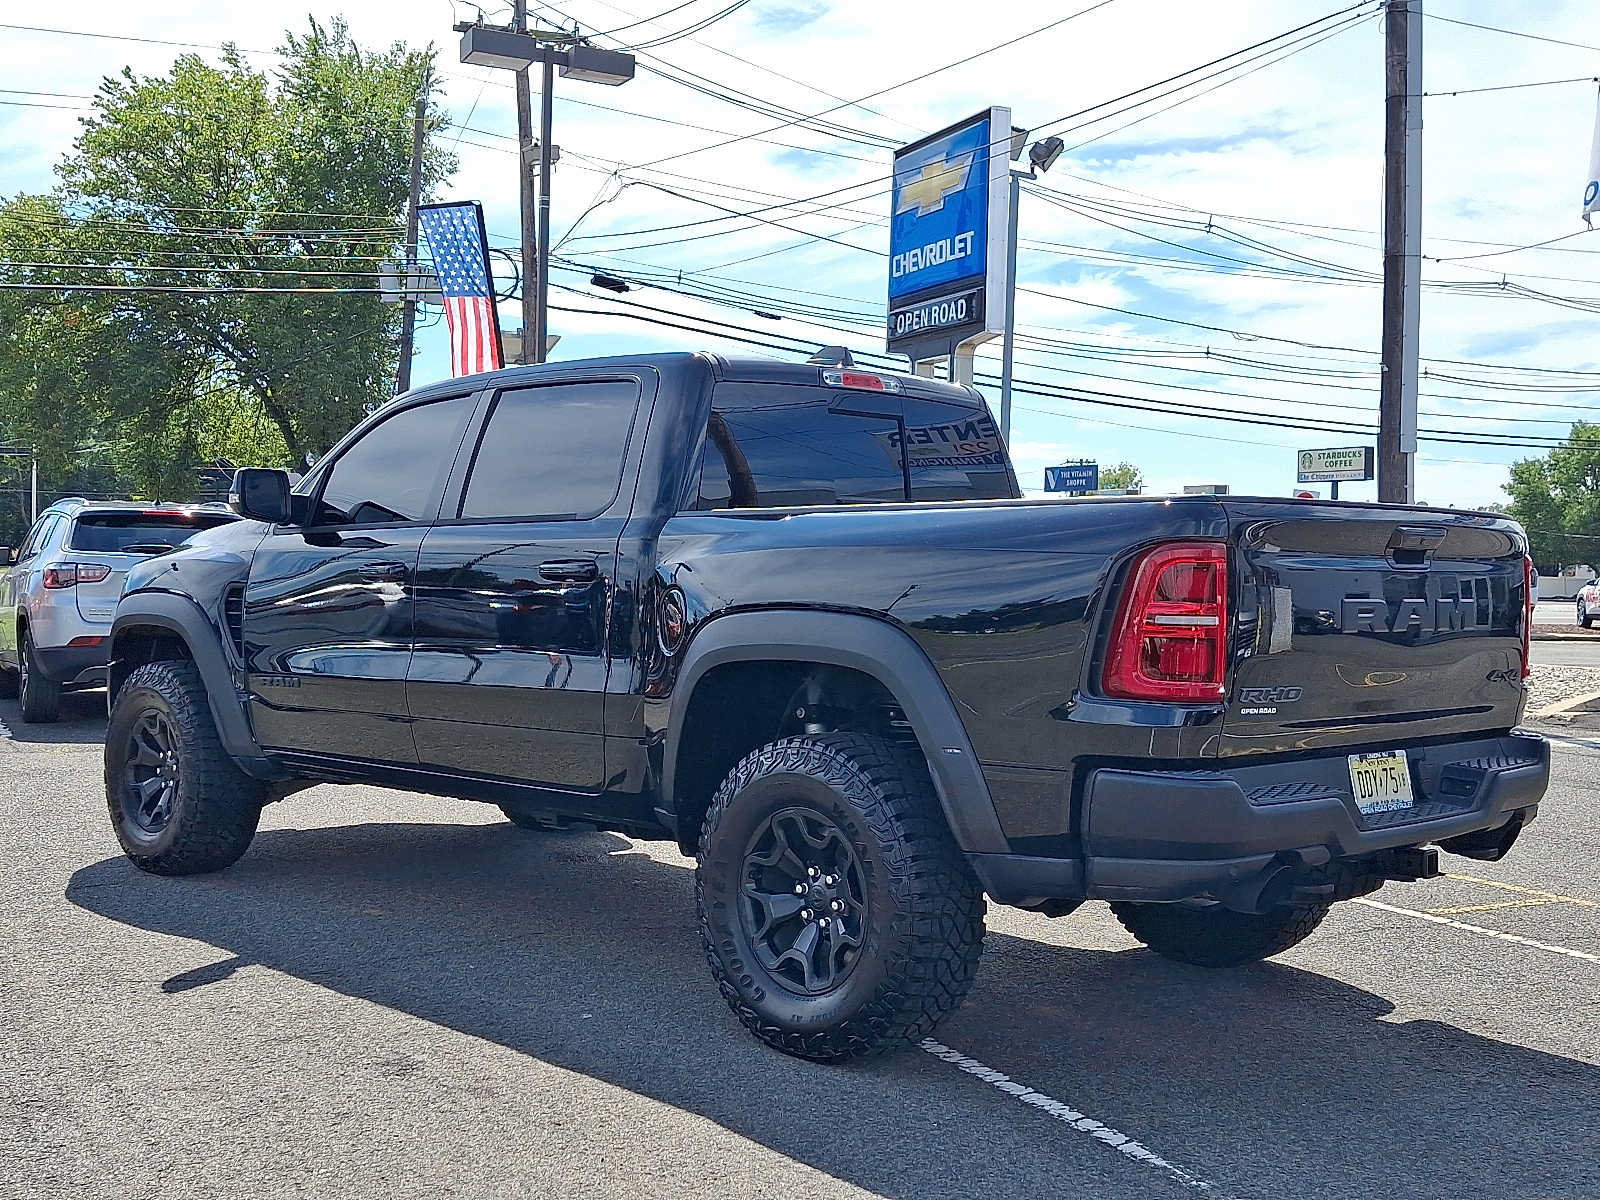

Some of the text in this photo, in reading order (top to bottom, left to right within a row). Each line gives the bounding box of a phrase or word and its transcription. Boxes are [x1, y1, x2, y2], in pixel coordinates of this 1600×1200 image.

[892, 231, 975, 278] CHEVROLET
[896, 299, 967, 333] OPEN ROAD
[1317, 450, 1362, 460] STARBUCKS
[1324, 460, 1353, 468] COFFEE
[1061, 470, 1093, 479] THE VITAMIN
[1066, 479, 1086, 487] SHOPPE
[1340, 598, 1475, 634] RAM
[1240, 686, 1303, 703] RHO
